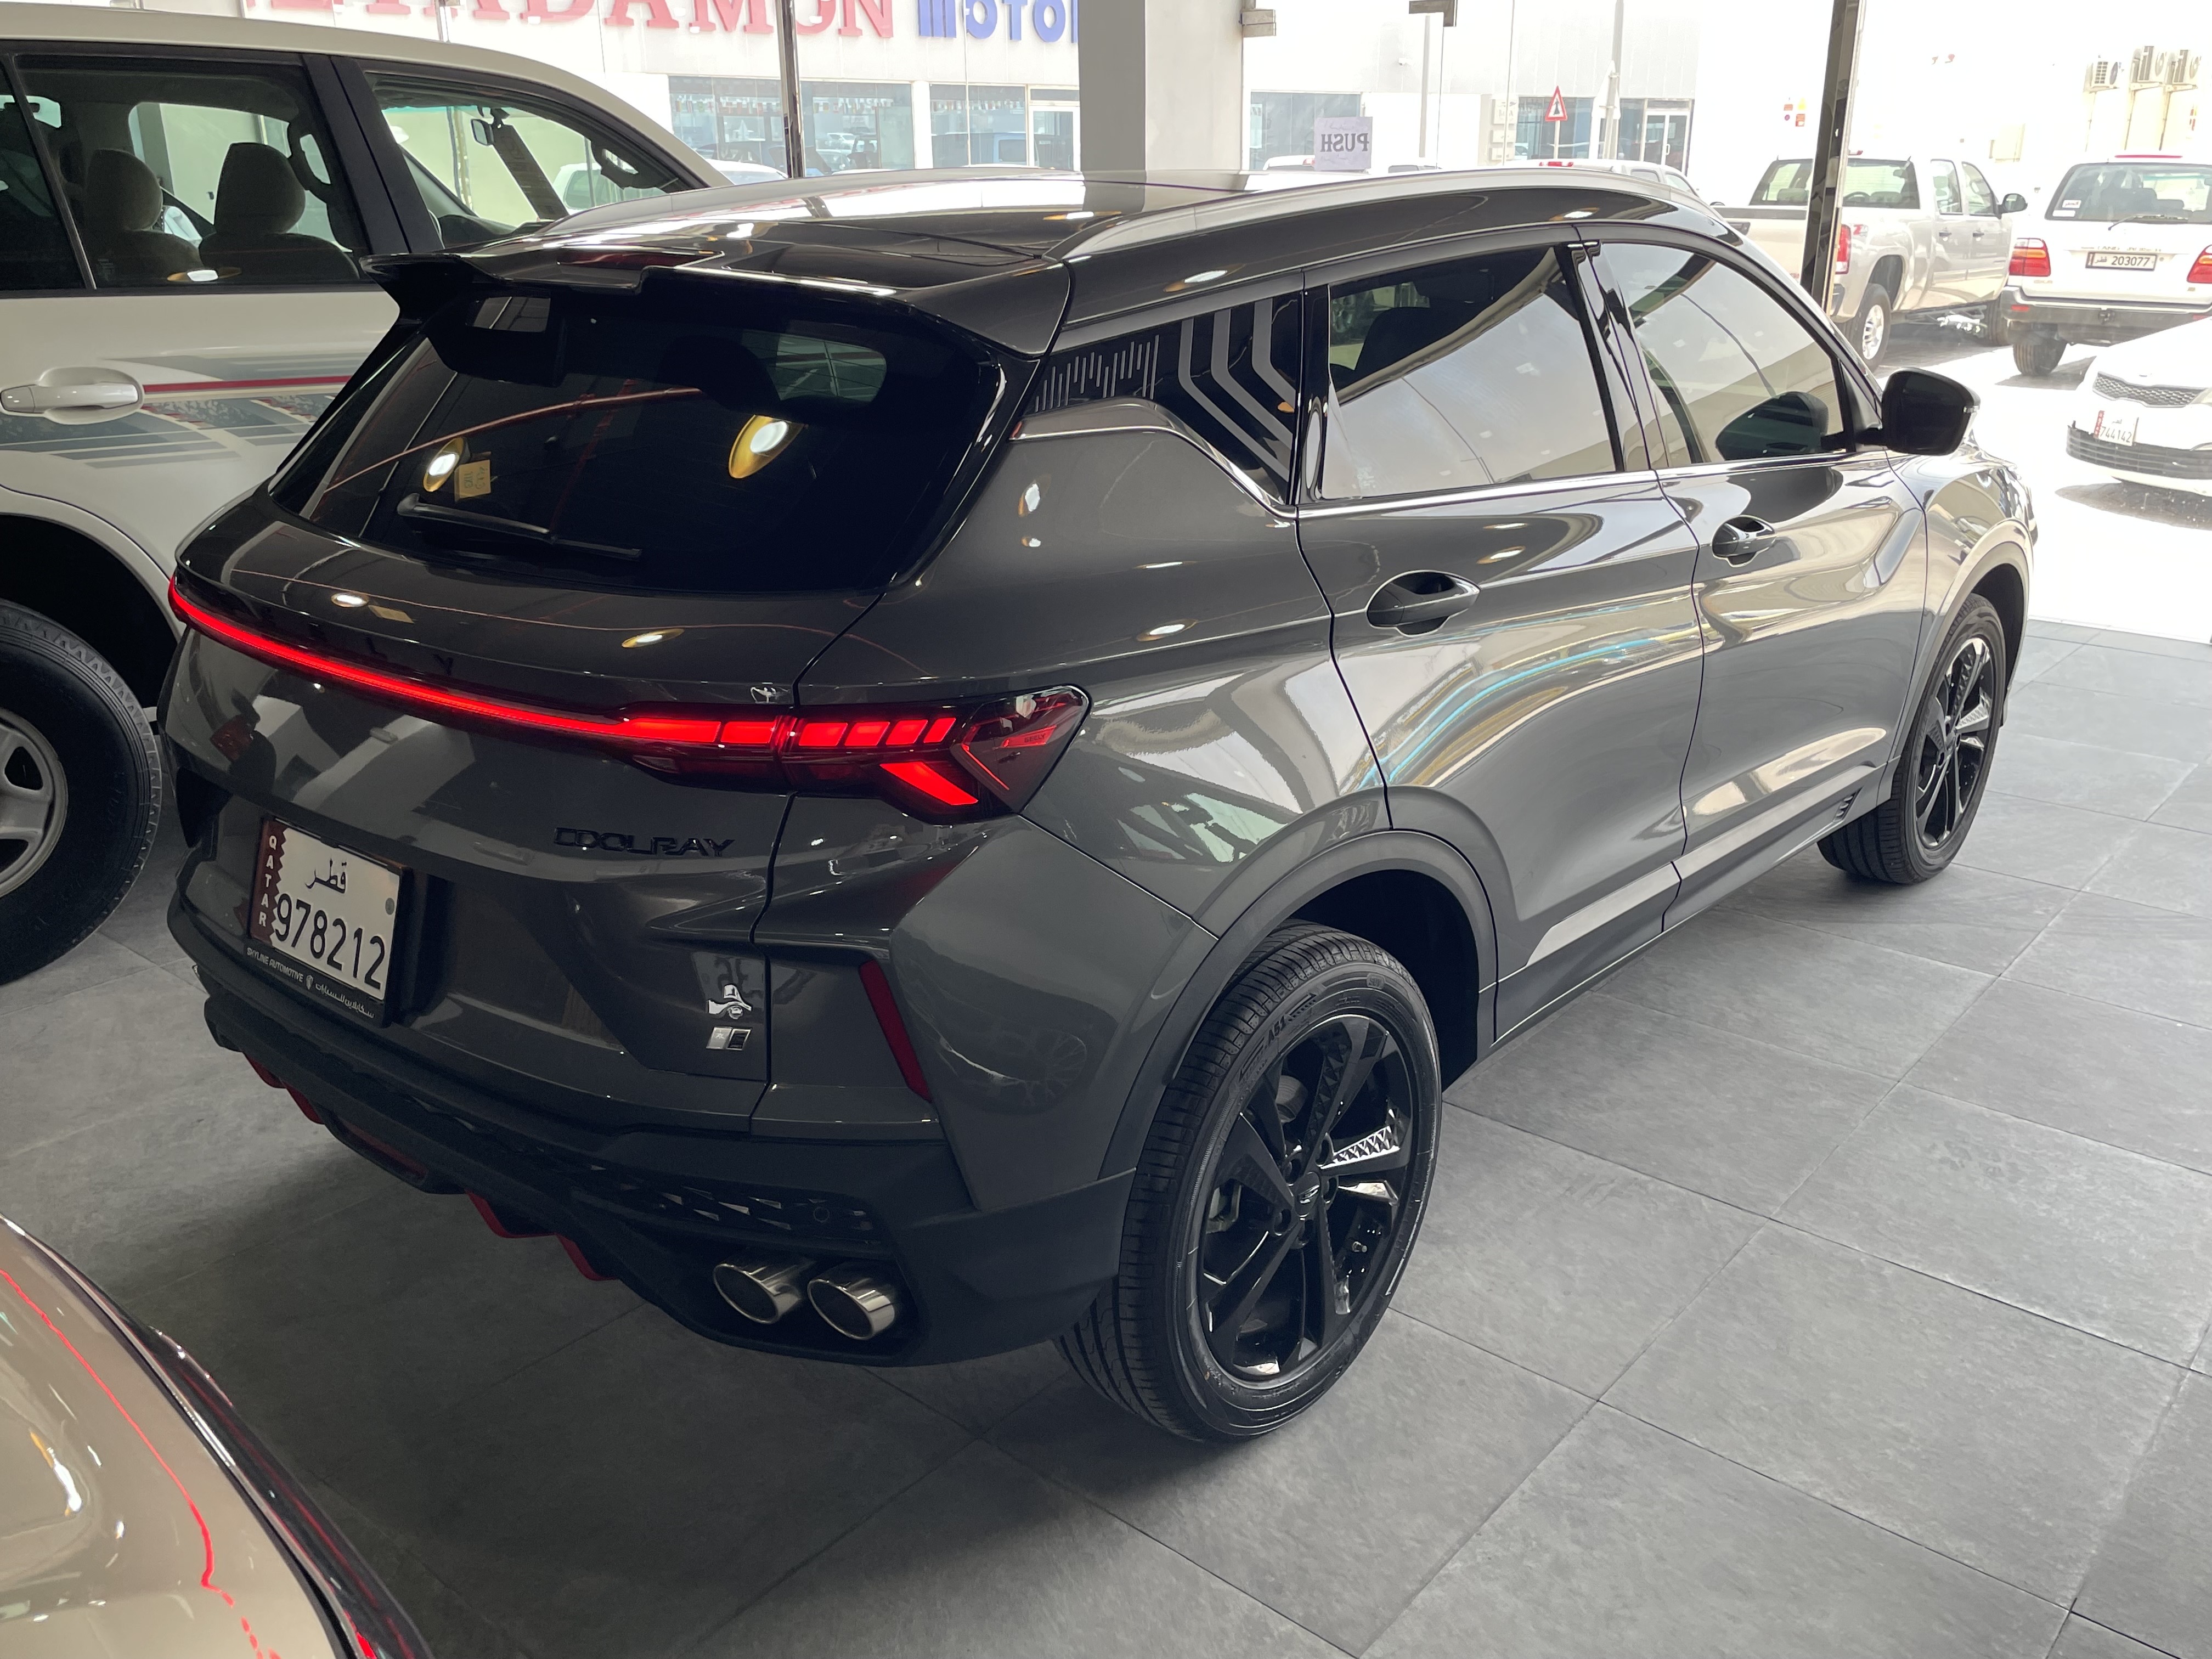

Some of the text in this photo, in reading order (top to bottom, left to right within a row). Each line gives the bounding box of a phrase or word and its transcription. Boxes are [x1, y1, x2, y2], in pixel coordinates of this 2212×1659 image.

[918, 0, 1078, 43] MOTO
[2111, 255, 2151, 267] 203077
[2100, 426, 2132, 443] 744142
[258, 835, 278, 928] QATAR
[305, 857, 347, 894] قطر
[274, 893, 385, 990] 978212
[247, 947, 304, 983] SKYLINE AUTOMOTIVE
